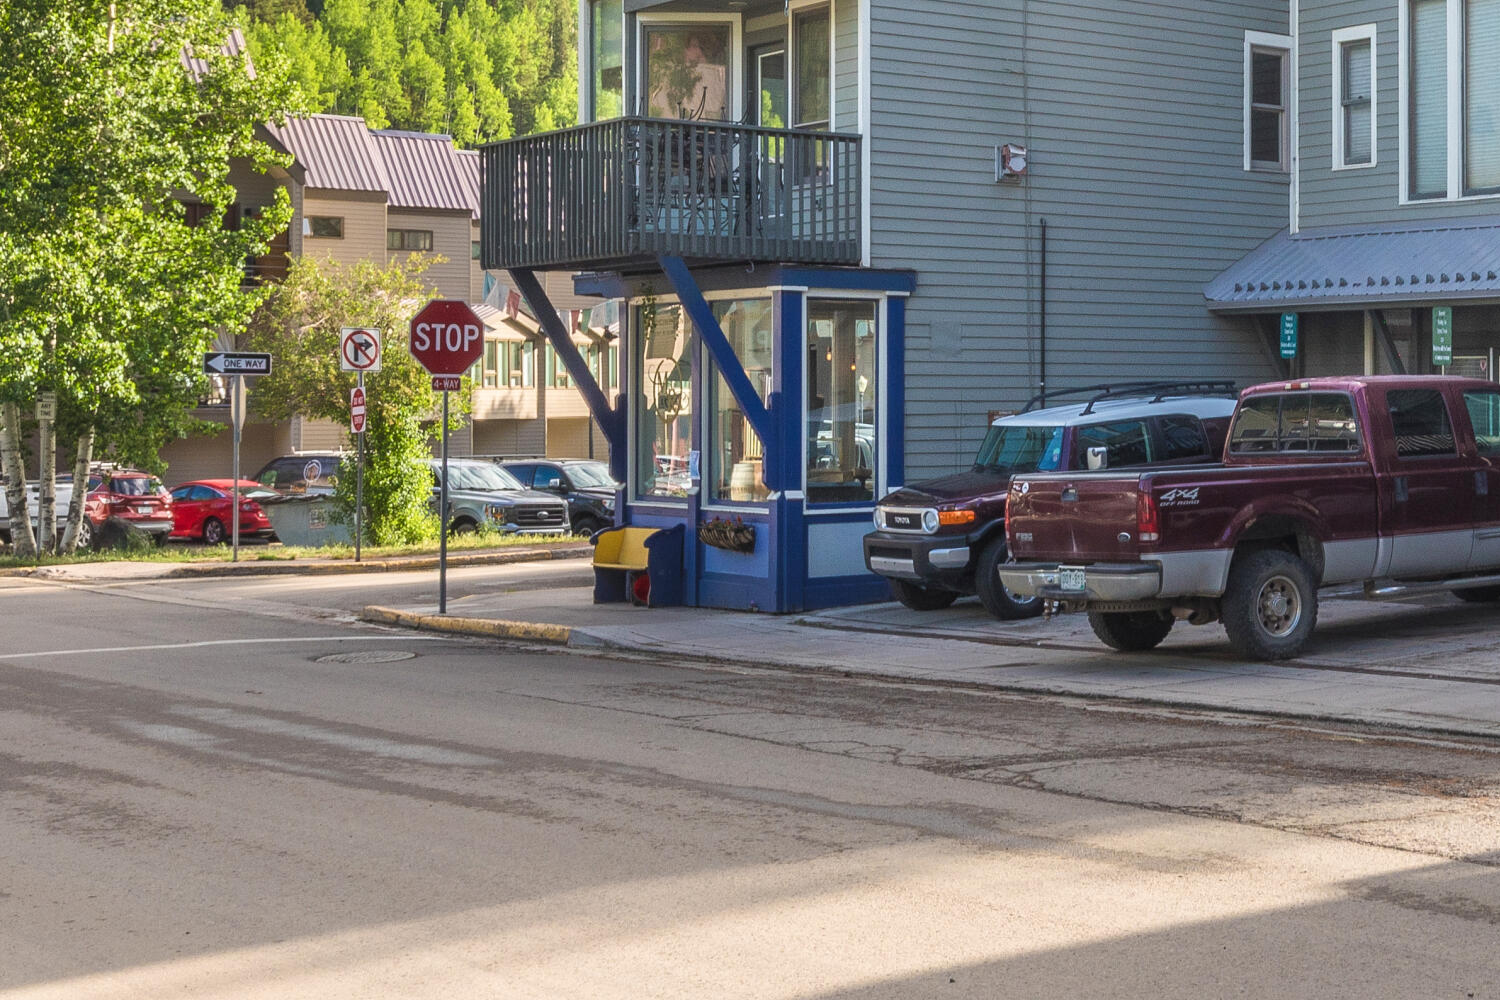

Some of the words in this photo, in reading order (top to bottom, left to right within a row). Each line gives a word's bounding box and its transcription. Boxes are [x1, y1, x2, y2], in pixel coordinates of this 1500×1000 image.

[414, 322, 480, 352] STOP
[223, 359, 242, 368] ONE
[245, 359, 264, 368] WAY
[433, 379, 459, 389] 4-WAY
[1160, 487, 1200, 501] 4x4
